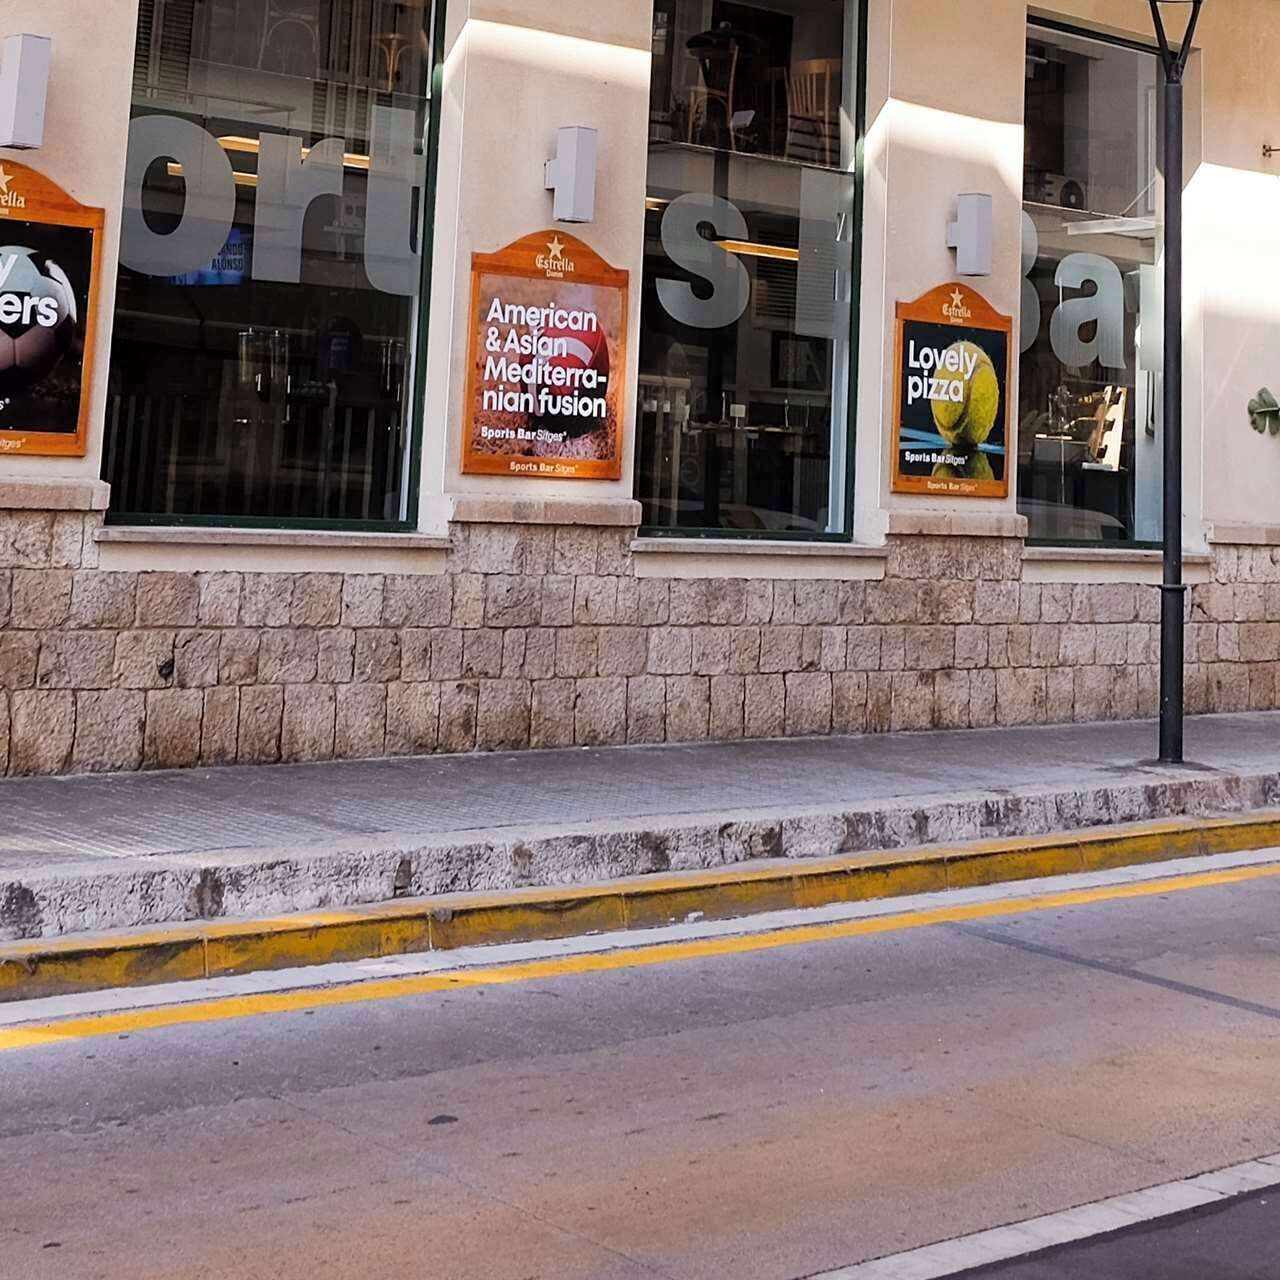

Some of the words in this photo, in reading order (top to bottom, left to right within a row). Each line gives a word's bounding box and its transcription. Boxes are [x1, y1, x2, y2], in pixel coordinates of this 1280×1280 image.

[536, 255, 574, 271] Estrella
[486, 298, 597, 332] American
[942, 303, 971, 317] Estrella
[486, 327, 500, 352] &
[503, 329, 568, 357] Asian
[484, 356, 607, 389] Mediterra-
[908, 340, 978, 380] Lovely
[482, 385, 534, 413] nian
[538, 387, 607, 418] fusion
[907, 370, 964, 405] pizza
[481, 426, 516, 440] Sports
[517, 428, 536, 441] Bar
[510, 461, 538, 472] Sports
[904, 451, 931, 463] Sports
